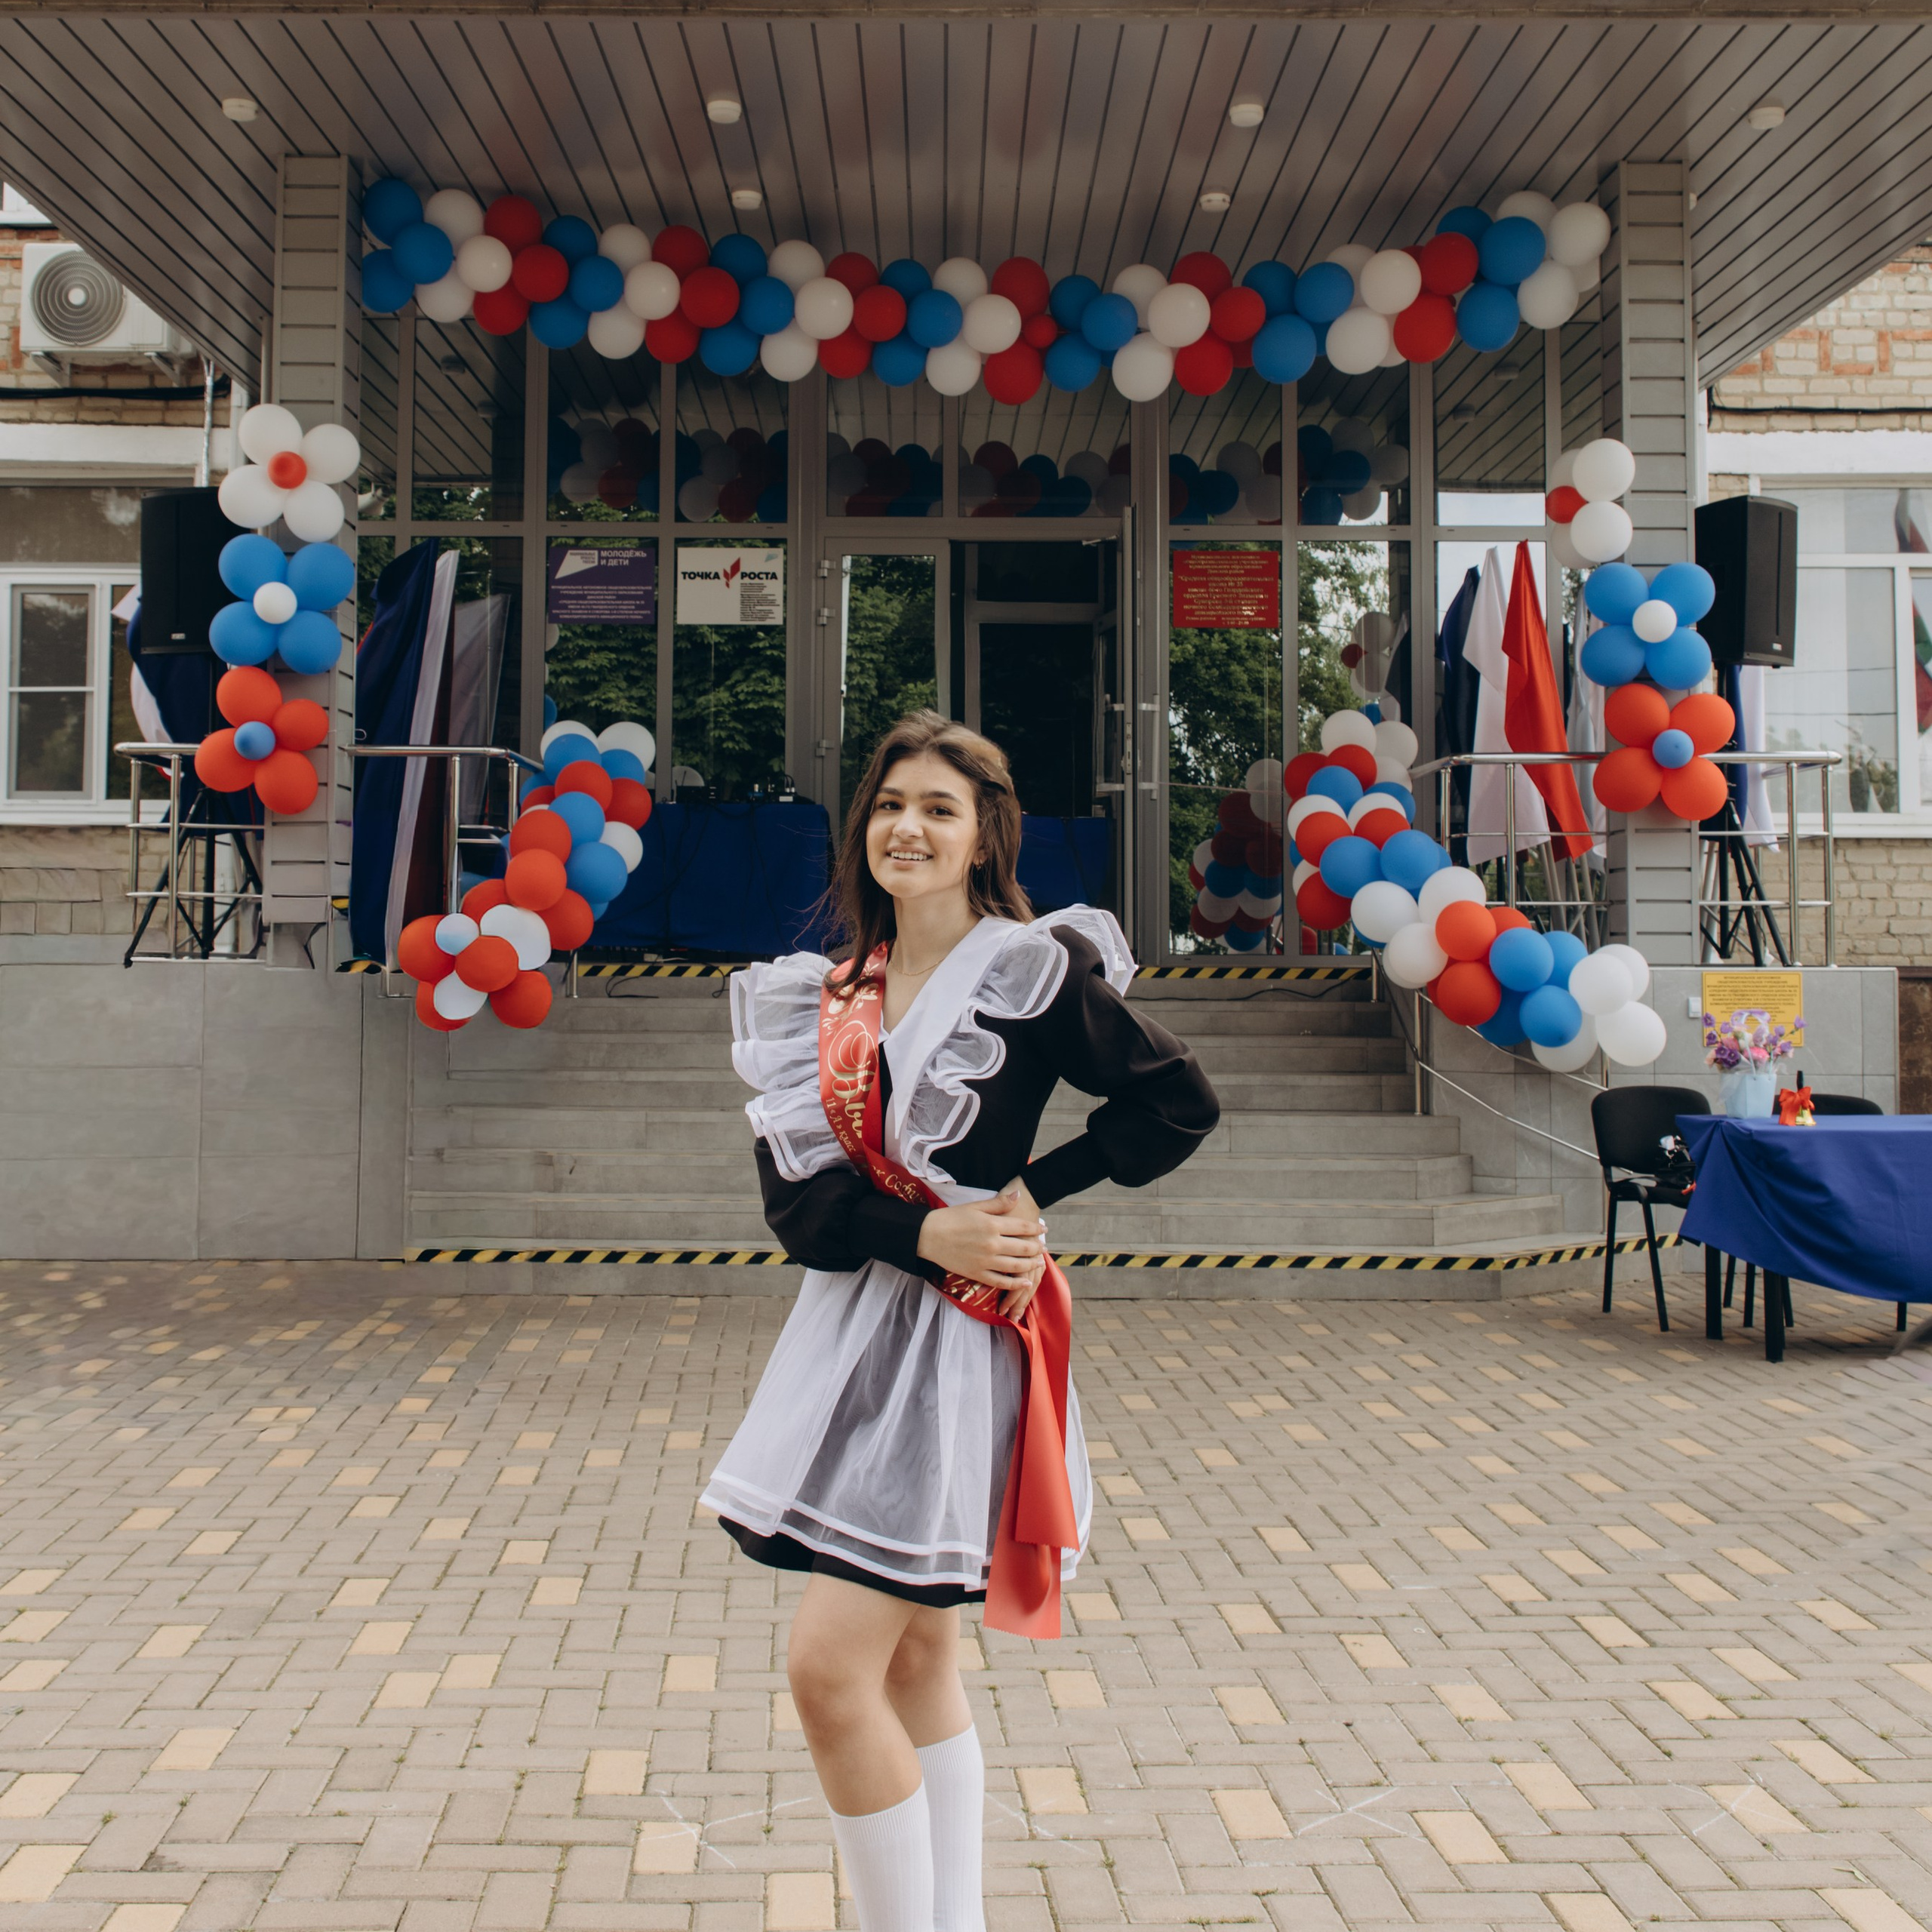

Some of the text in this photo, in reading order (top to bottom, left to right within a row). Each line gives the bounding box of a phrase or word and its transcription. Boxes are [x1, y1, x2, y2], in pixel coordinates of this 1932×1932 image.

[601, 549, 647, 558] МОЛОДЁЖЬ
[681, 571, 778, 580] ТОЧКА РОСТА
[838, 1130, 857, 1152] класс
